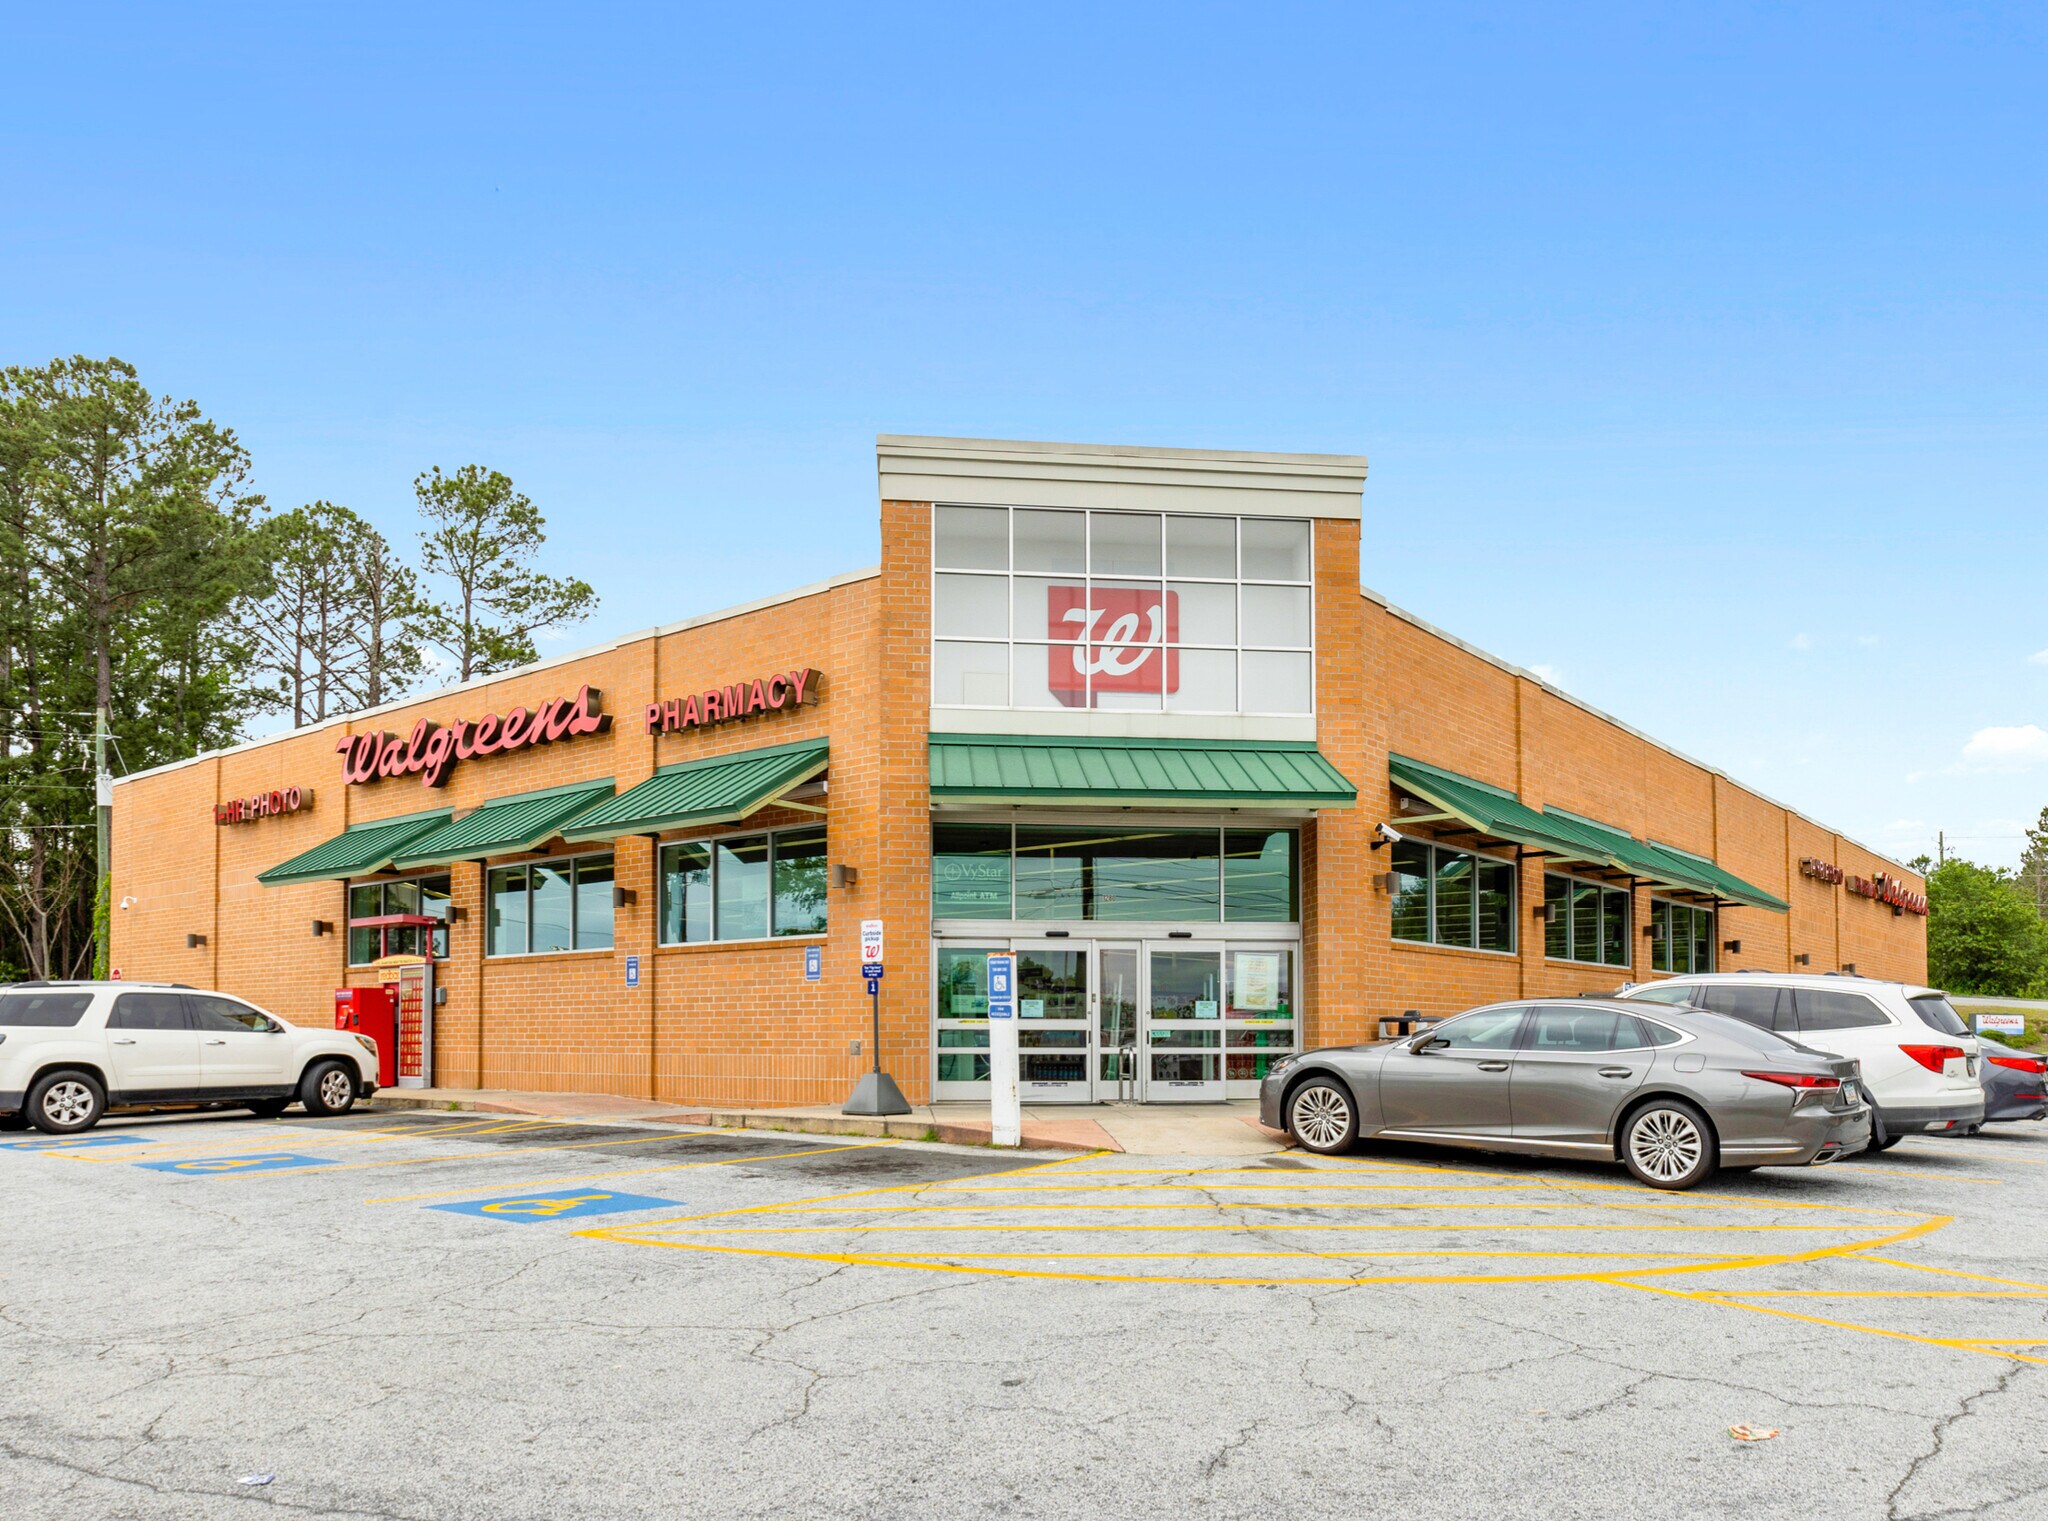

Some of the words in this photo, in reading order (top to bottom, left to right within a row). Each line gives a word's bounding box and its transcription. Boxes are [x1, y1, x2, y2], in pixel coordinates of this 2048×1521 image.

[645, 668, 812, 735] PHARMACY
[336, 684, 603, 788] Walgreens
[212, 798, 246, 826] 1-HR
[250, 785, 301, 819] PHOTO
[961, 863, 1004, 880] VyStar
[979, 891, 998, 900] ATM
[1981, 1015, 2020, 1028] Walgreens
